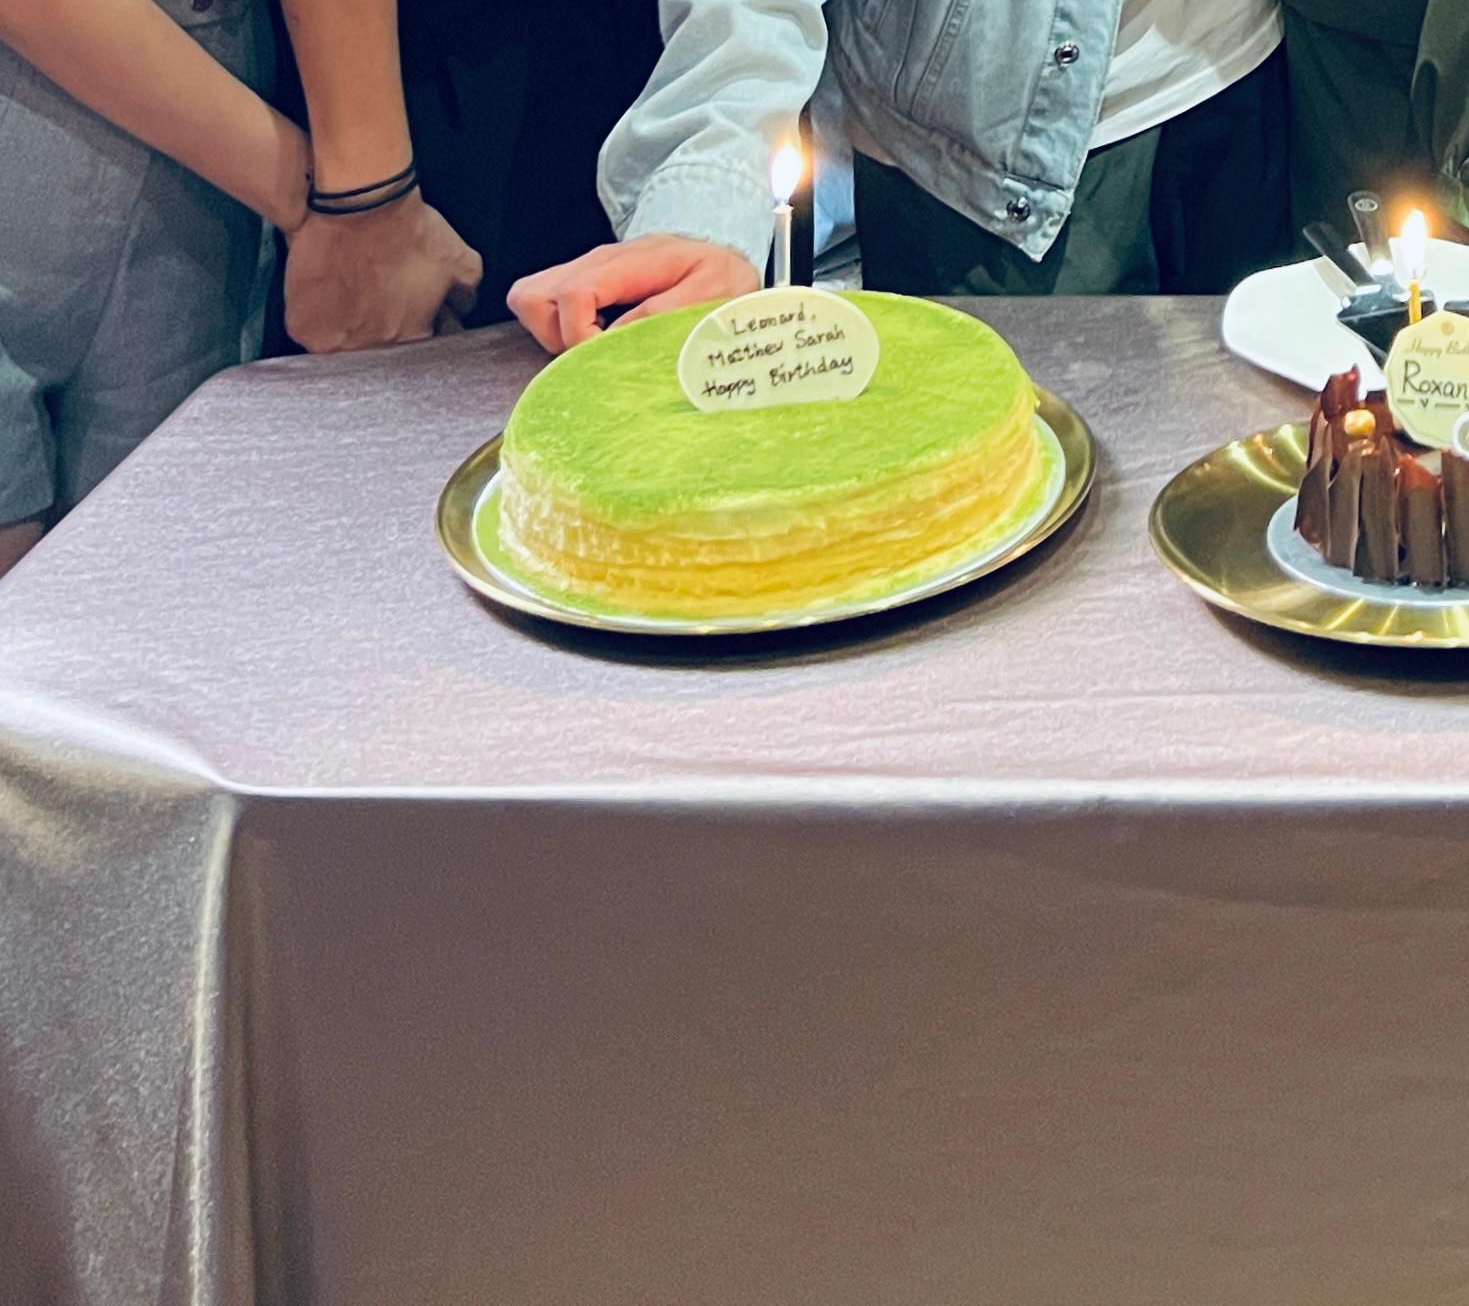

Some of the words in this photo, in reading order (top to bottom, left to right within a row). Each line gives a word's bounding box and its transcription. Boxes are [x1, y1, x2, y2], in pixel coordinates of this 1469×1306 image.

[794, 324, 846, 349] Sarah
[701, 379, 756, 399] Happy
[769, 355, 854, 387] Birthday
